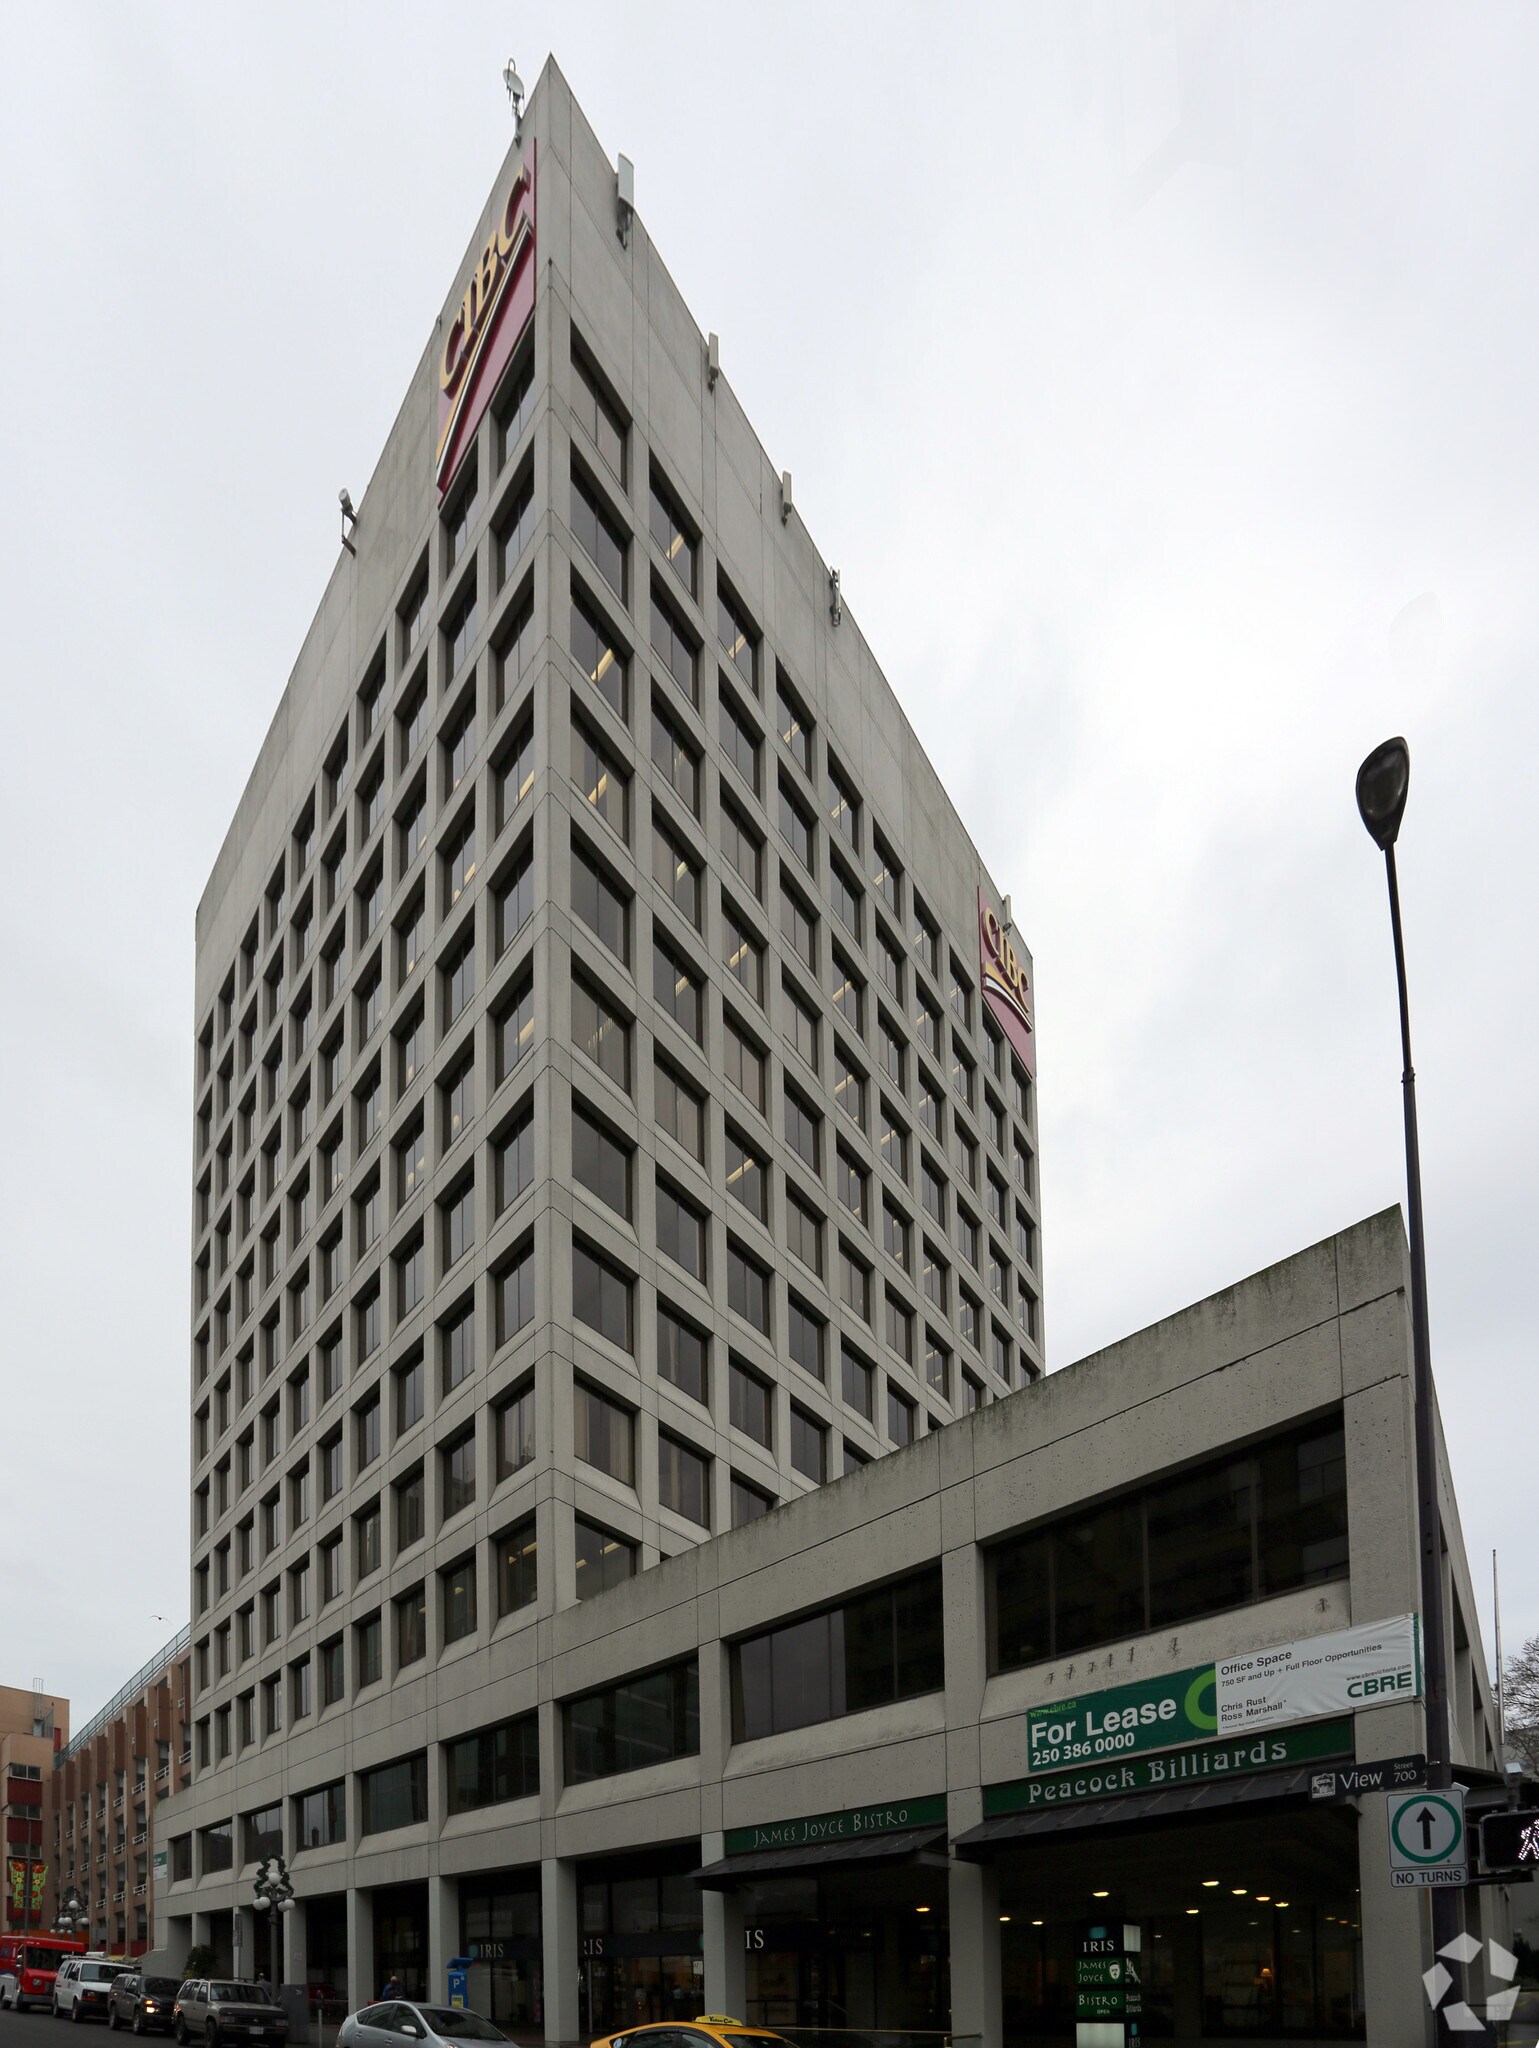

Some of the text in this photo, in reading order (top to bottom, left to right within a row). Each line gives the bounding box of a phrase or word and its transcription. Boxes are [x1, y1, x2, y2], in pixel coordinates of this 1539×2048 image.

[440, 163, 532, 399] CIBC
[980, 907, 1030, 1014] CIBC
[1221, 1651, 1292, 1676] Office Space
[1221, 1679, 1235, 1688] 750
[1236, 1676, 1247, 1684] SF
[1248, 1672, 1262, 1681] and
[1264, 1669, 1275, 1679] Up
[1286, 1661, 1300, 1672] Full
[1302, 1657, 1323, 1669] Floor
[1325, 1643, 1382, 1663] Opportunities
[1346, 1663, 1412, 1681] www.cbrevictoria.com
[1347, 1671, 1413, 1699] CBRE
[1221, 1696, 1267, 1713] Chris Rust
[1031, 1698, 1177, 1748] For Lease
[1221, 1712, 1243, 1722] Ross
[1032, 1732, 1135, 1766] 250 386 0000
[1028, 1740, 1288, 1804] Peacock Billiards
[1393, 1761, 1414, 1771] Street
[1340, 1772, 1383, 1789] View
[1393, 1770, 1417, 1783] 700
[754, 1809, 909, 1848] JAMES JOYCE BISTRO
[1396, 1870, 1462, 1884] NO TURNS
[480, 1943, 504, 1958] IRIS
[1082, 1939, 1115, 1953] IRIS
[1078, 1961, 1107, 1971] JAMES
[453, 1978, 460, 1988] P
[1078, 1974, 1104, 1983] JOYCE
[1078, 1994, 1118, 2006] BISTRO
